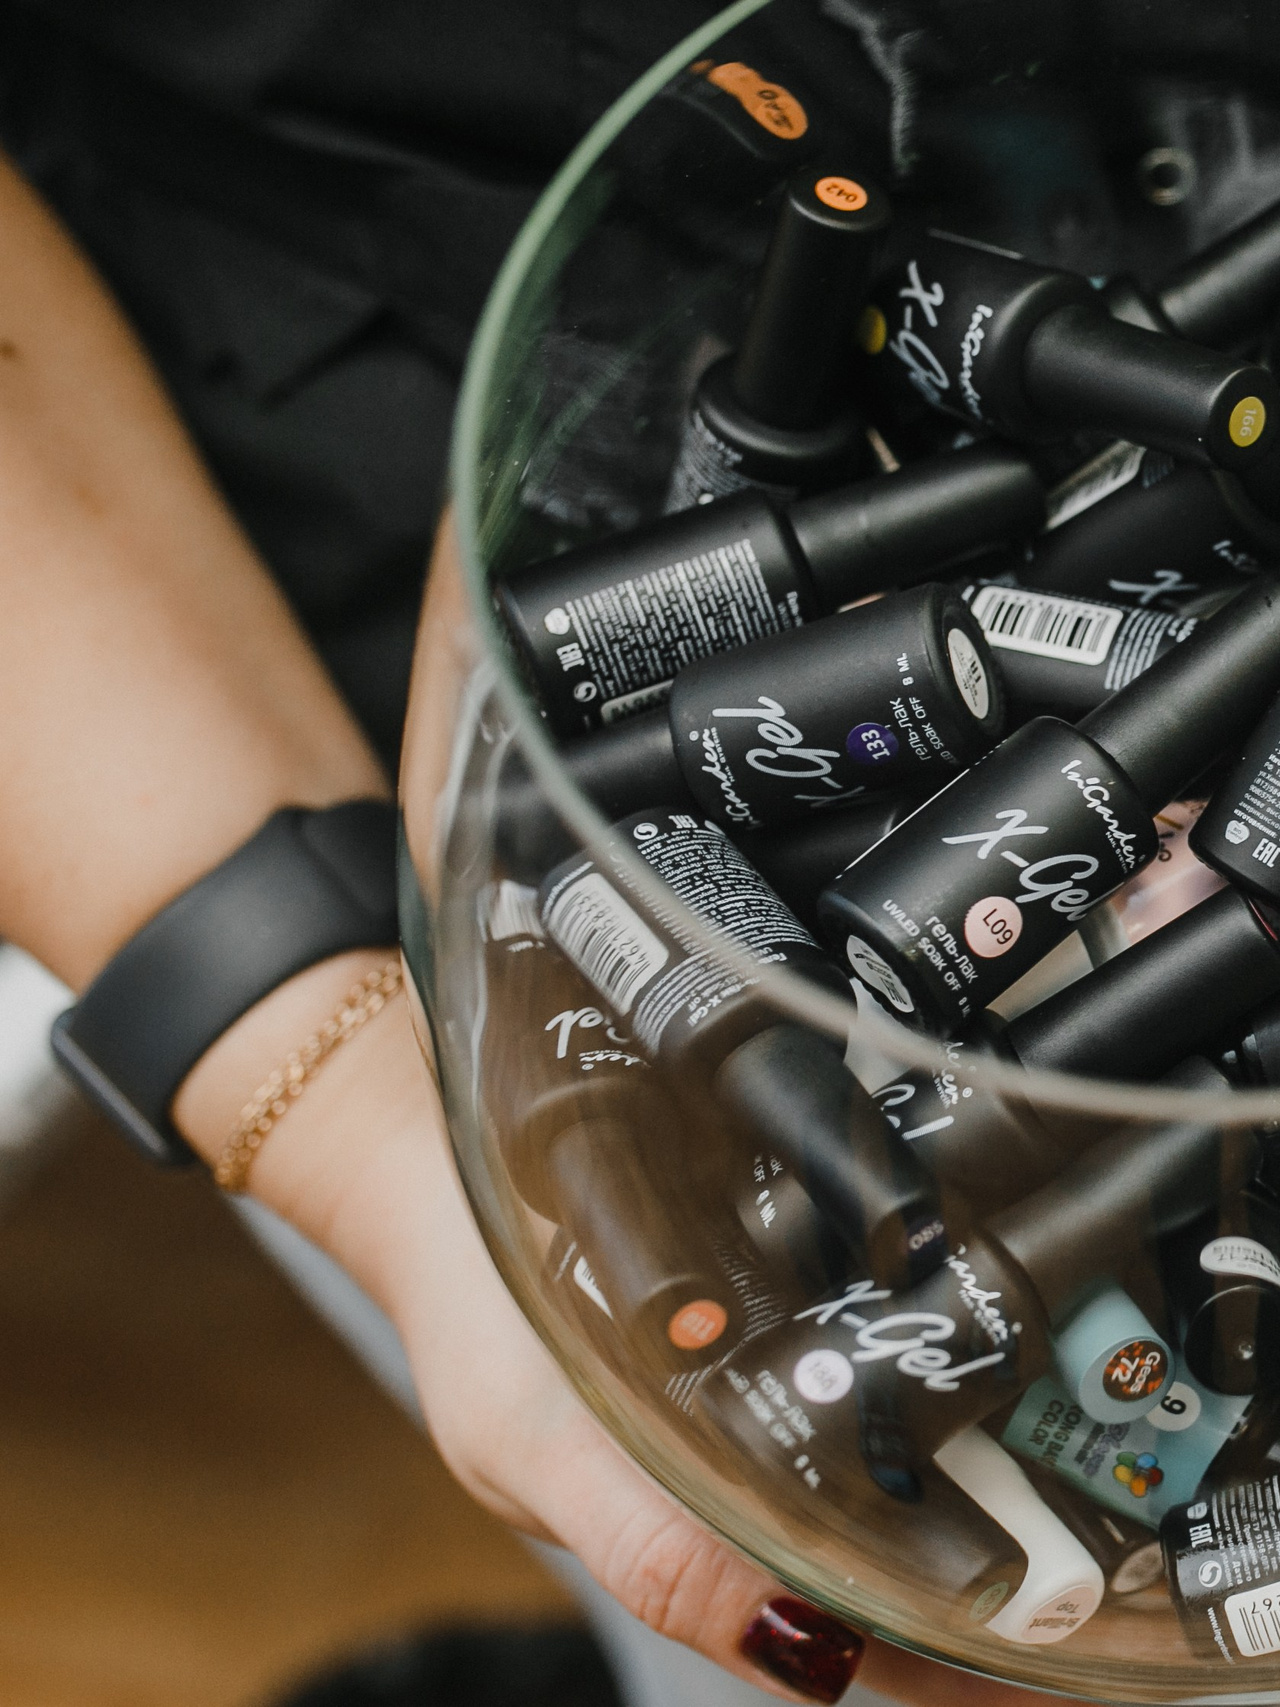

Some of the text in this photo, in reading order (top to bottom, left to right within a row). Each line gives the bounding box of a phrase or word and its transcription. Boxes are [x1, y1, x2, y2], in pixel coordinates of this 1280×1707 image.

[1239, 408, 1257, 437] 166
[896, 652, 910, 673] ML
[902, 676, 914, 686] 8
[908, 697, 927, 719] OFF
[889, 697, 931, 760] гель-лак
[861, 729, 890, 760] 133
[640, 842, 662, 855] Дата
[942, 809, 1099, 920] X-Gel
[982, 908, 1014, 945] L09
[916, 936, 947, 971] SOAK
[943, 971, 962, 991] OFF
[922, 913, 977, 983] гель-лак
[792, 1280, 1005, 1390] X-Gel
[1111, 1353, 1136, 1385] 72
[1129, 1350, 1162, 1395] Geos
[1160, 1392, 1187, 1415] 9
[1028, 1397, 1066, 1446] COLOR
[1230, 1560, 1244, 1585] Дата
[1057, 1600, 1081, 1614] Top
